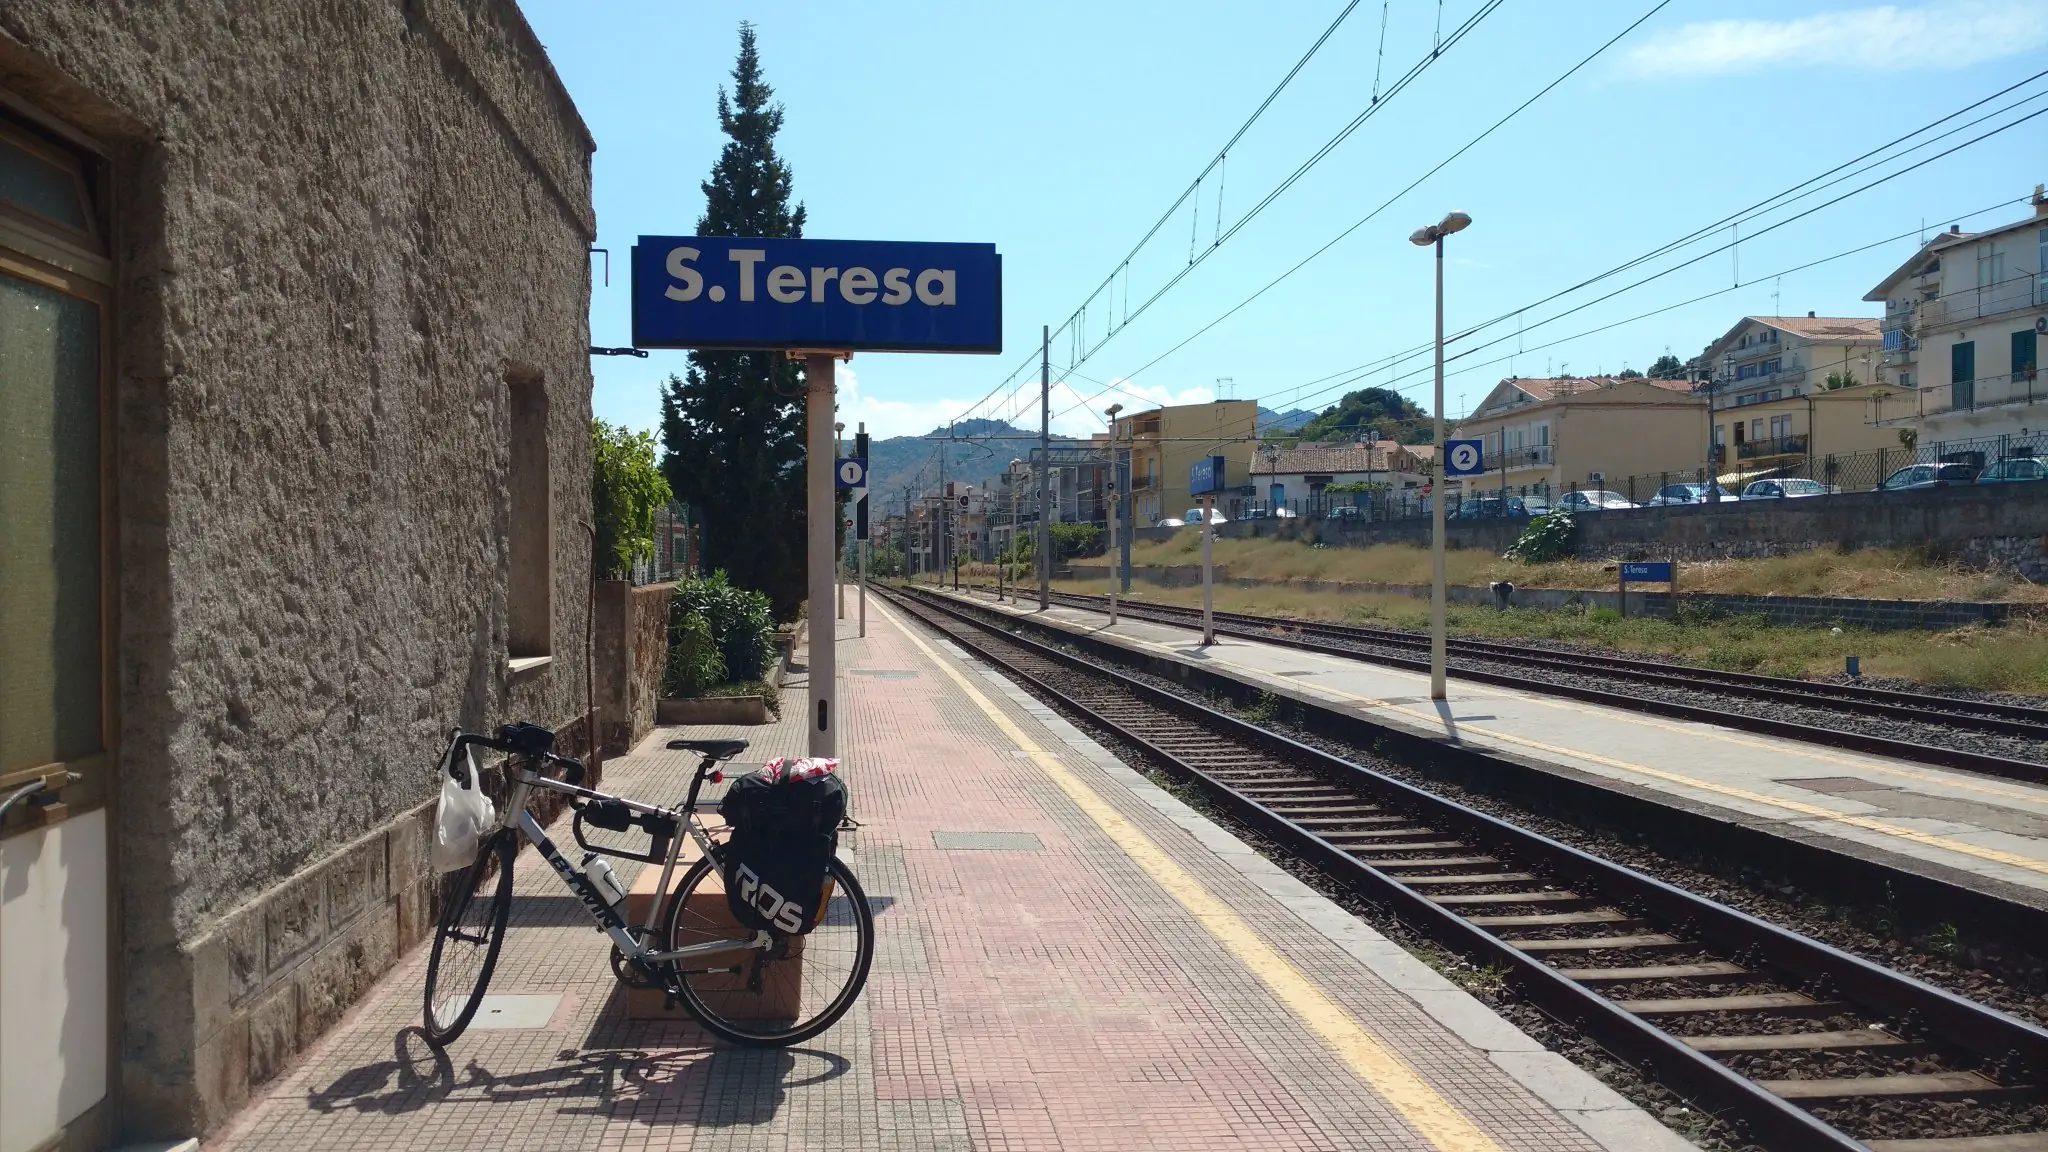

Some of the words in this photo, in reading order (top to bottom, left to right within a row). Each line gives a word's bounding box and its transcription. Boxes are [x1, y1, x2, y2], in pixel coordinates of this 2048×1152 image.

[664, 246, 956, 306] S.Teresa
[1459, 450, 1470, 464] 2
[848, 467, 854, 479] 1
[1630, 565, 1648, 574] Teresa
[735, 862, 803, 934] ROS
